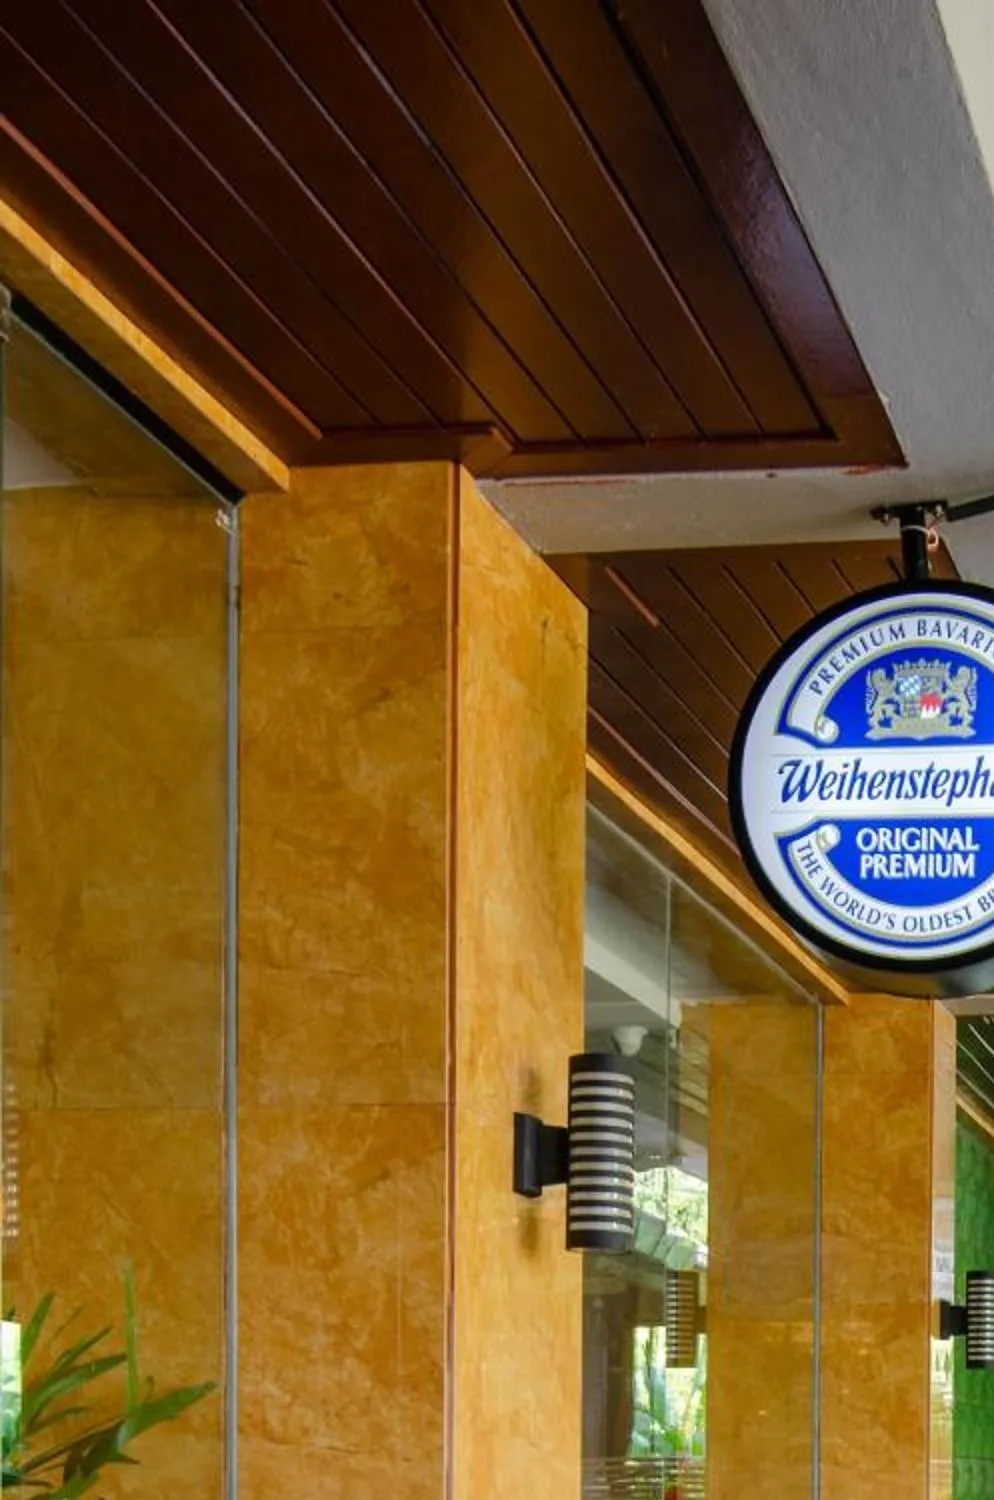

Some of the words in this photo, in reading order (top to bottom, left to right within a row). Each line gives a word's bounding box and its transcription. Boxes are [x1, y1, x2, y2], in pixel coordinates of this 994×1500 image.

[808, 622, 907, 696] PREMIUM
[855, 825, 980, 853] ORIGINAL
[796, 842, 823, 877] THE
[820, 876, 897, 931] WORLD'S
[902, 905, 974, 933] OLDEST
[859, 853, 976, 880] PREMIUM
